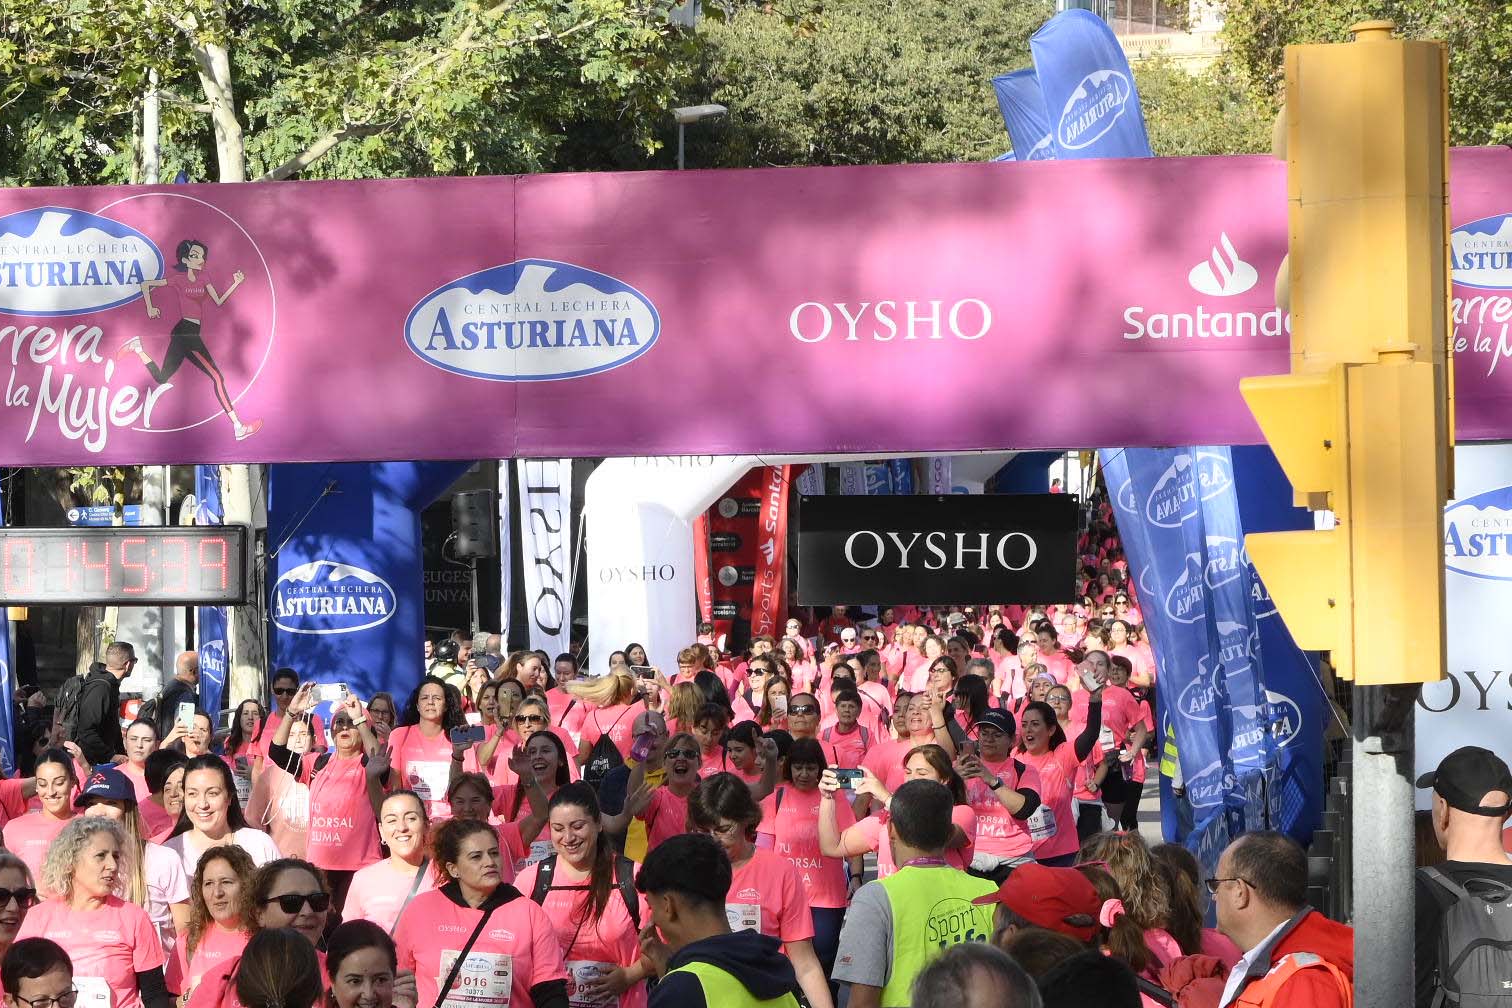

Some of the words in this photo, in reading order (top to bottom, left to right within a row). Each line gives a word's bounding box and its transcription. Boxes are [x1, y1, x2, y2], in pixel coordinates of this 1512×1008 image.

[66, 242, 139, 255] LECHERA
[463, 302, 544, 314] CENTRAL
[550, 299, 632, 312] LECHERA
[424, 307, 640, 351] ASTURIANA
[789, 298, 993, 343] OYSHO
[5, 367, 30, 407] la
[24, 358, 173, 453] Mujer
[844, 531, 1038, 571] OYSHO
[599, 564, 675, 583] OYSHO
[276, 590, 387, 617] ASTURIANA
[311, 817, 354, 829] DORSAL
[928, 907, 977, 942] Sport
[463, 976, 487, 987] 016
